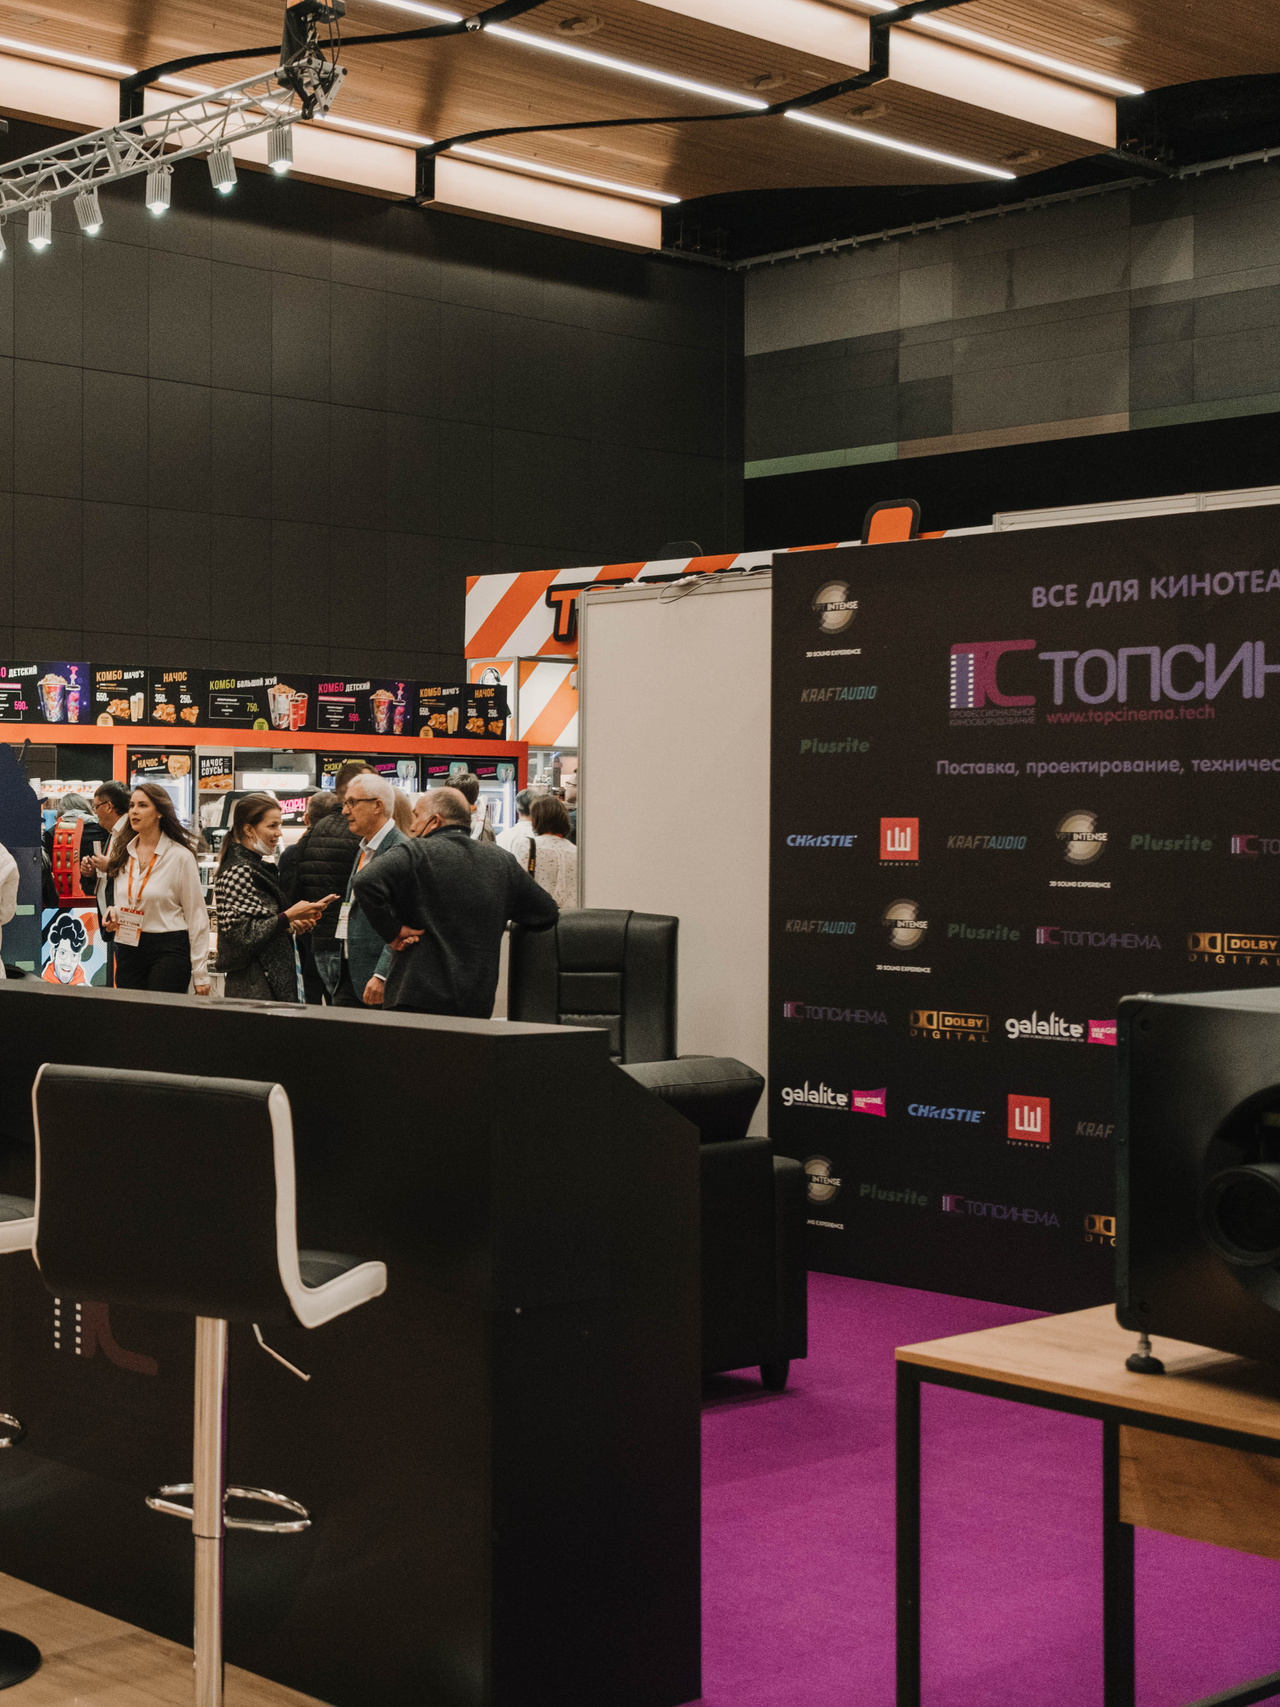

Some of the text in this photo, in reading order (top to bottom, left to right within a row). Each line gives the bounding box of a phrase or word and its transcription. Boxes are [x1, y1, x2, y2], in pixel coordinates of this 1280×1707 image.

[1032, 583, 1078, 608] ВСЕ
[1086, 578, 1139, 608] ДЛЯ
[826, 601, 859, 611] INTENSE
[8, 664, 38, 678] ДЕТСКИЙ
[96, 670, 123, 682] КОМБО
[163, 671, 187, 683] НАЧОС
[209, 676, 278, 691] КОМБО БОЛЬШОЙ ЖУЙ
[318, 681, 371, 694] КОМБО ДЕТСКИЙ
[800, 685, 878, 702] KRAFTAUDIO
[1046, 704, 1216, 725] www.topcinema.tech
[800, 737, 871, 754] Plusrite
[137, 758, 159, 769] НАЧОС
[201, 758, 224, 768] НАЧОС
[936, 760, 1020, 777] Поставка,
[1026, 758, 1185, 778] проектирование,
[201, 766, 224, 776] СОУСЫ
[786, 834, 855, 848] CHRISTIE
[947, 834, 1028, 850] KRAFTAUDIO
[1072, 832, 1108, 841] INTENSE
[1129, 834, 1213, 851] Plusrite
[785, 919, 857, 935] KRAFTAUDIO
[896, 920, 928, 929] INTENSE
[947, 922, 1020, 942] Plusrite
[1060, 930, 1161, 950] ТОПСИНЕМА
[1230, 938, 1278, 950] DOLBY
[804, 1005, 888, 1025] ТОПСИНЕМА
[944, 1016, 984, 1029] DOLBY
[1005, 1010, 1084, 1039] galalite
[909, 1029, 989, 1043] DIGITAL
[781, 1080, 849, 1106] galalite
[907, 1103, 983, 1124] CHRISTIE
[811, 1175, 842, 1187] INTENSE
[859, 1183, 928, 1207] Plusrite
[965, 1198, 1060, 1228] ТОПСИНЕМА
